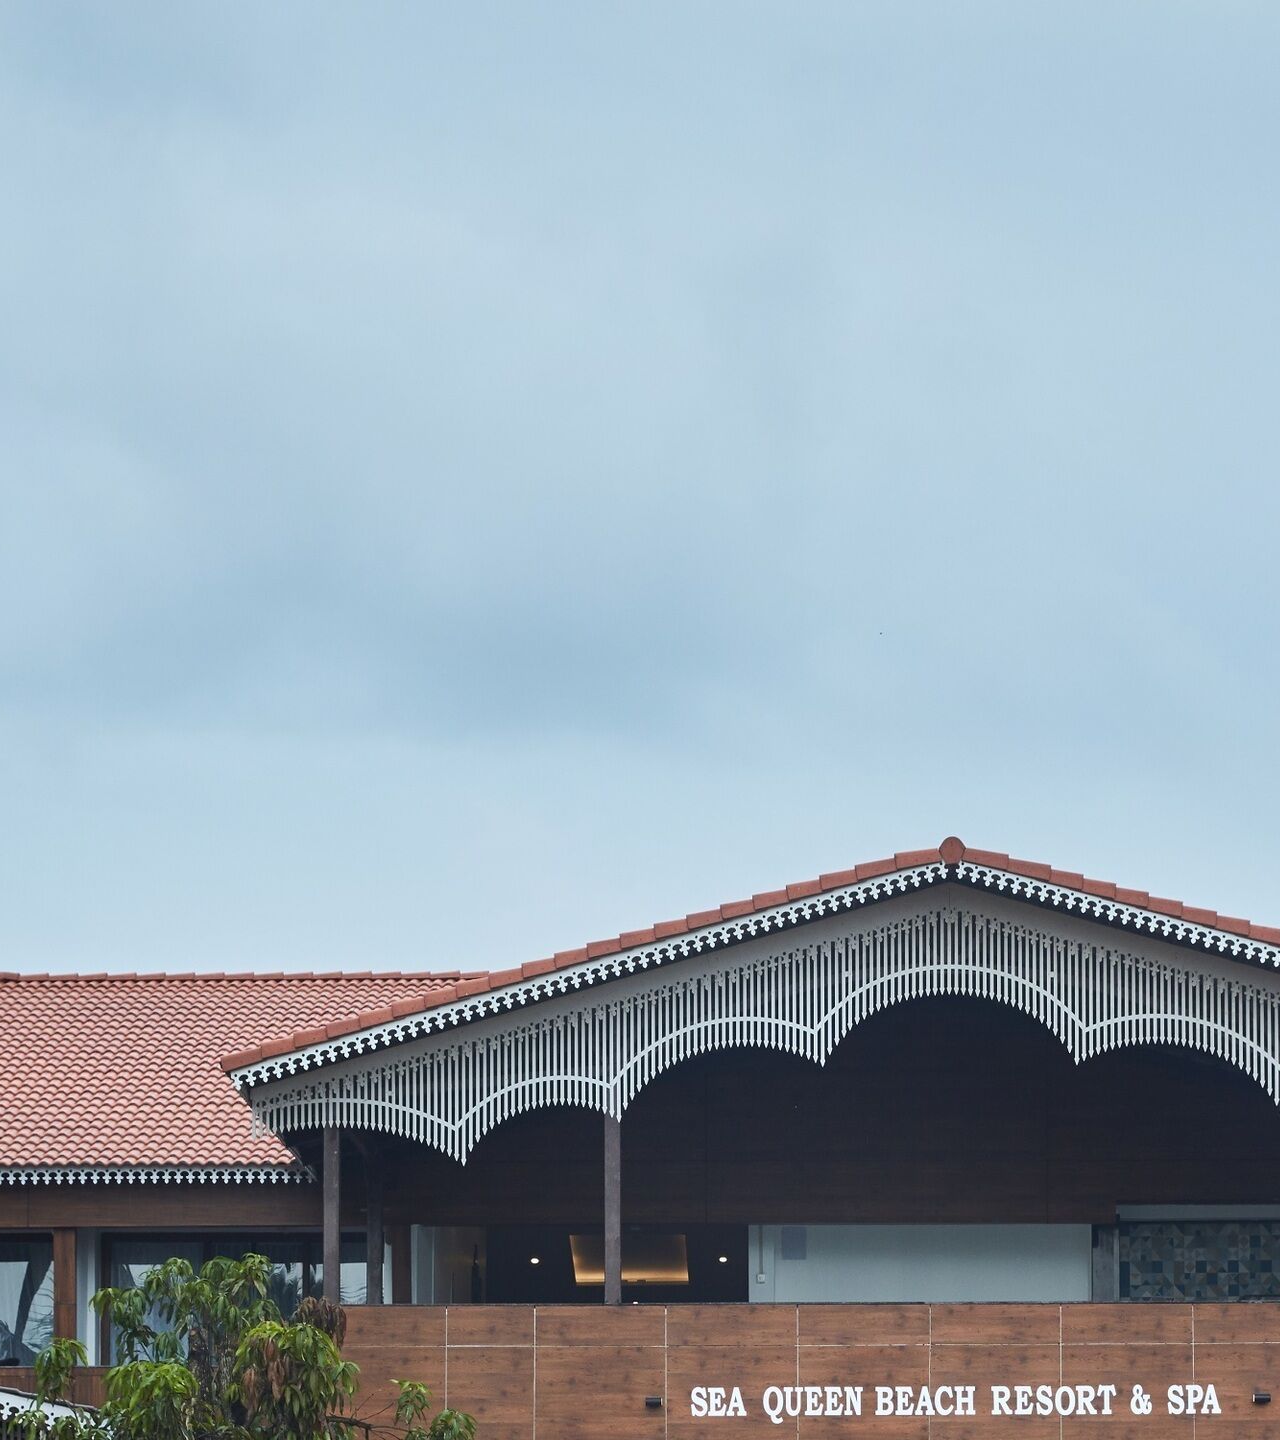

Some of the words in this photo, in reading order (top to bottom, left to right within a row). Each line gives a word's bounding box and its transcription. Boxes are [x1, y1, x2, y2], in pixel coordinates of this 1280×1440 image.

[690, 1386, 747, 1417] SEA
[762, 1386, 863, 1425] QUEEN
[875, 1386, 976, 1416] BEACH
[991, 1384, 1117, 1416] RESORT
[1130, 1384, 1152, 1415] &
[1167, 1384, 1222, 1415] SPA
